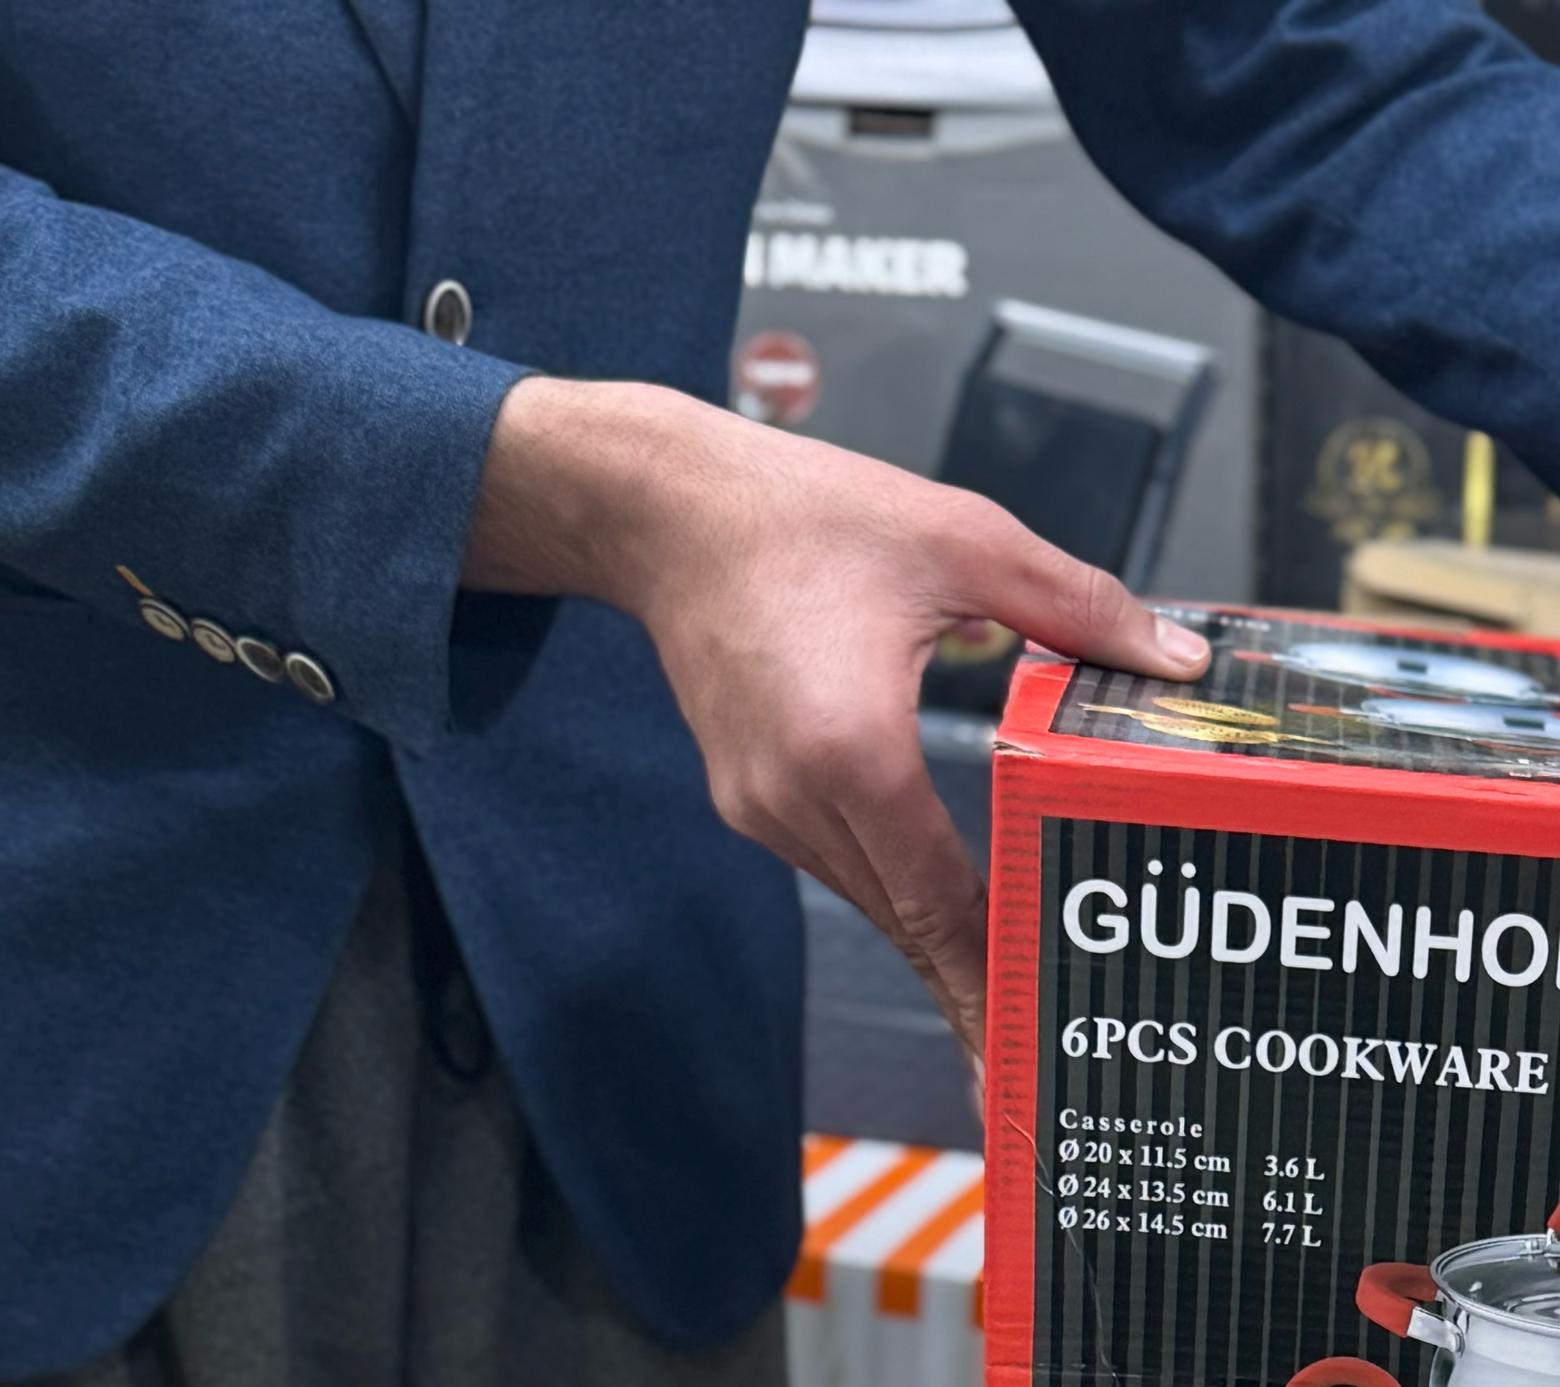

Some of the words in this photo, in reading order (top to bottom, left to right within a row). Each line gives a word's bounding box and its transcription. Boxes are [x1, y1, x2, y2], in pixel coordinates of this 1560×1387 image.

[1061, 1015, 1199, 1066] 6PCS
[1214, 1025, 1549, 1096] COOKWARE
[1059, 1108, 1203, 1139] Casserole
[1083, 1141, 1113, 1166] 20
[1118, 1149, 1134, 1166] x
[1140, 1142, 1188, 1170] 11.5
[1194, 1154, 1231, 1174] cm
[1264, 1154, 1299, 1179] 3.6
[1305, 1158, 1326, 1181] L
[1083, 1174, 1112, 1199] 24
[1116, 1183, 1132, 1200] x
[1139, 1178, 1186, 1204] 13.5
[1192, 1188, 1230, 1208] cm
[1262, 1189, 1298, 1213] 6.1
[1303, 1192, 1324, 1216] L
[1082, 1207, 1111, 1231] 26
[1115, 1216, 1132, 1232] x
[1138, 1211, 1184, 1237] 14.5
[1191, 1221, 1228, 1241] cm
[1261, 1222, 1296, 1246] 7.7
[1301, 1226, 1322, 1248] L
